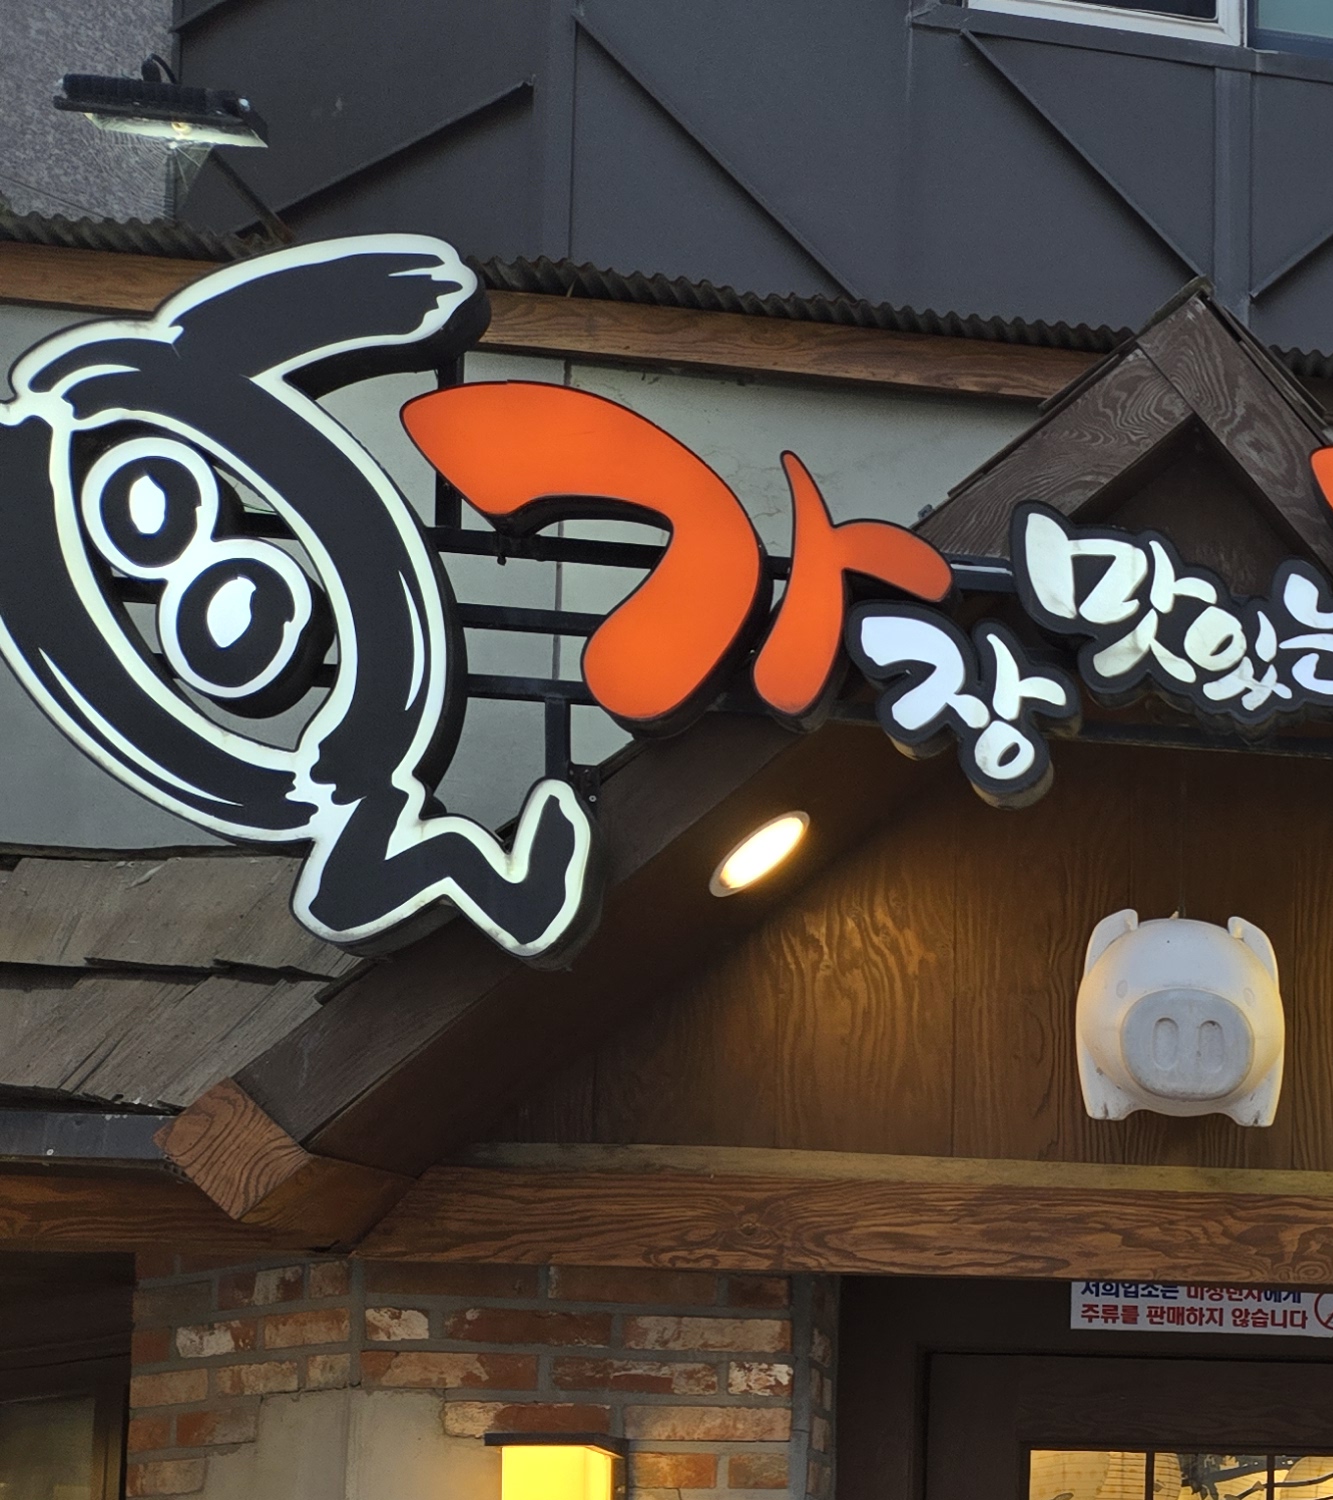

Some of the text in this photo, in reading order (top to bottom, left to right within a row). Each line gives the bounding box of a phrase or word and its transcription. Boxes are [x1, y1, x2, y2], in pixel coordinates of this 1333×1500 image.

[1080, 1303, 1309, 1330] 주류를 판매하지 않습니다
